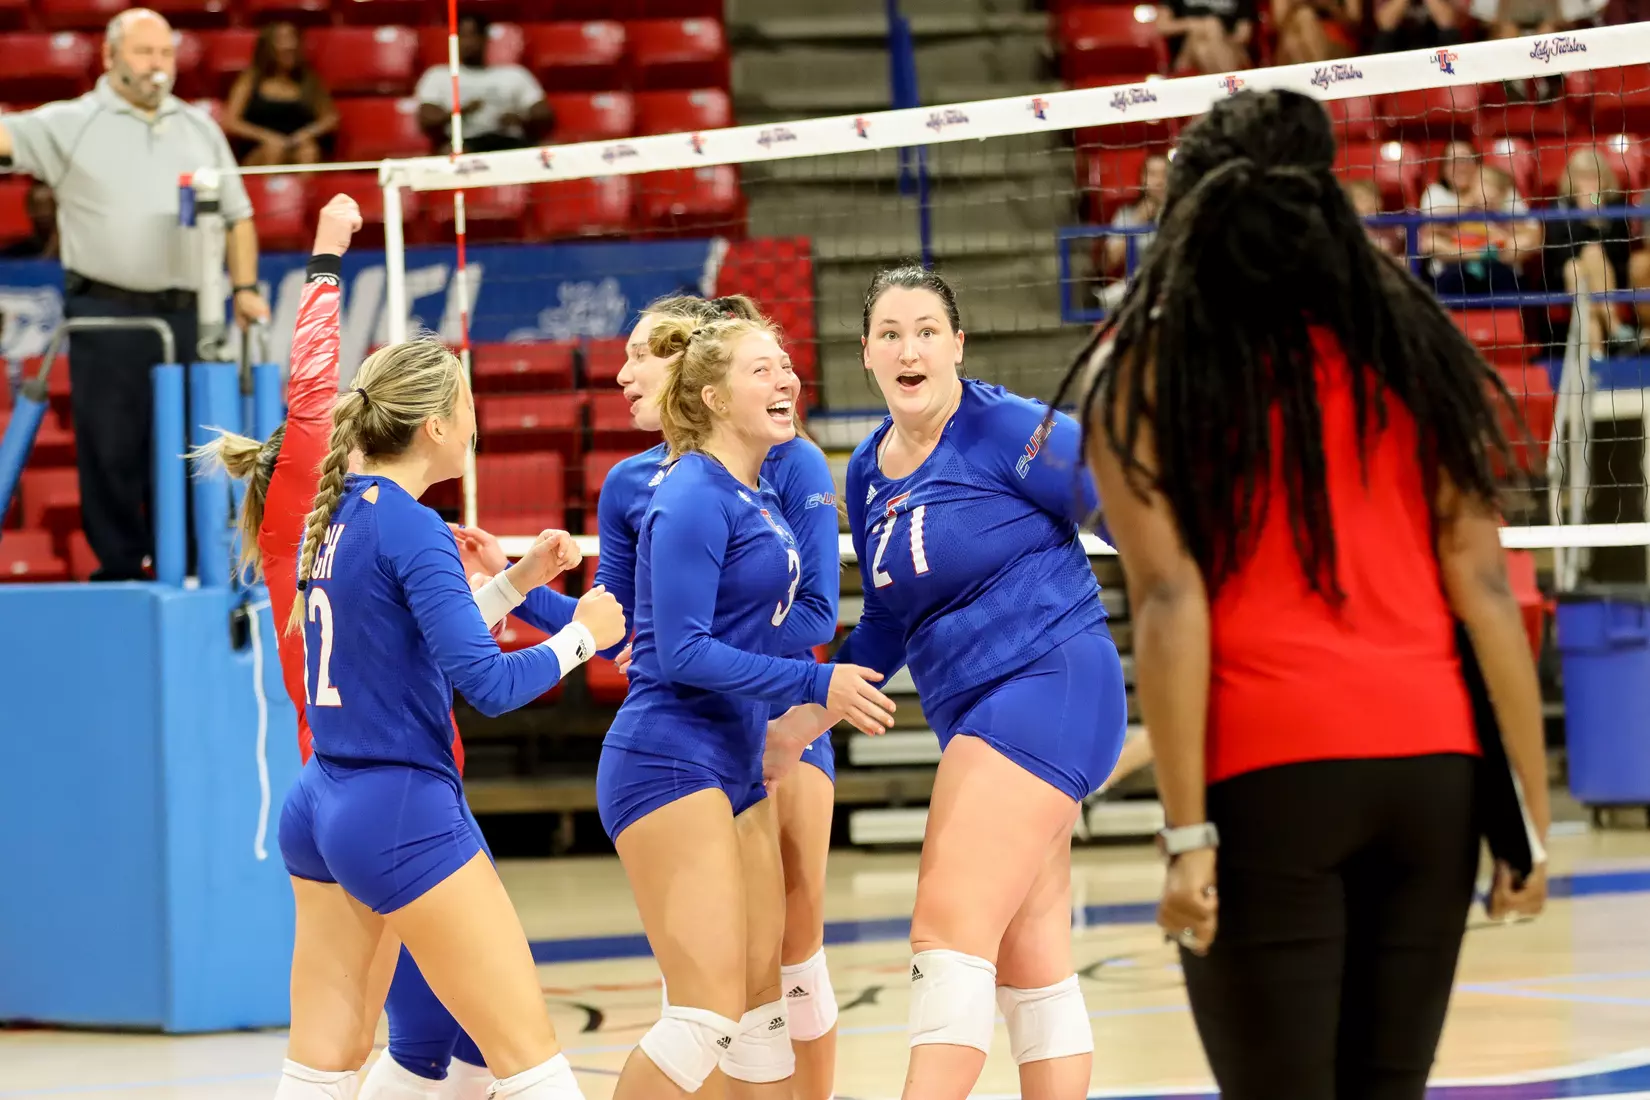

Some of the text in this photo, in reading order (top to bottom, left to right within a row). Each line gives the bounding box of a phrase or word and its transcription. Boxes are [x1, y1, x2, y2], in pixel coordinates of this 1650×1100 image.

[1530, 39, 1550, 63] Lady
[771, 547, 801, 627] 3
[871, 504, 931, 591] 21
